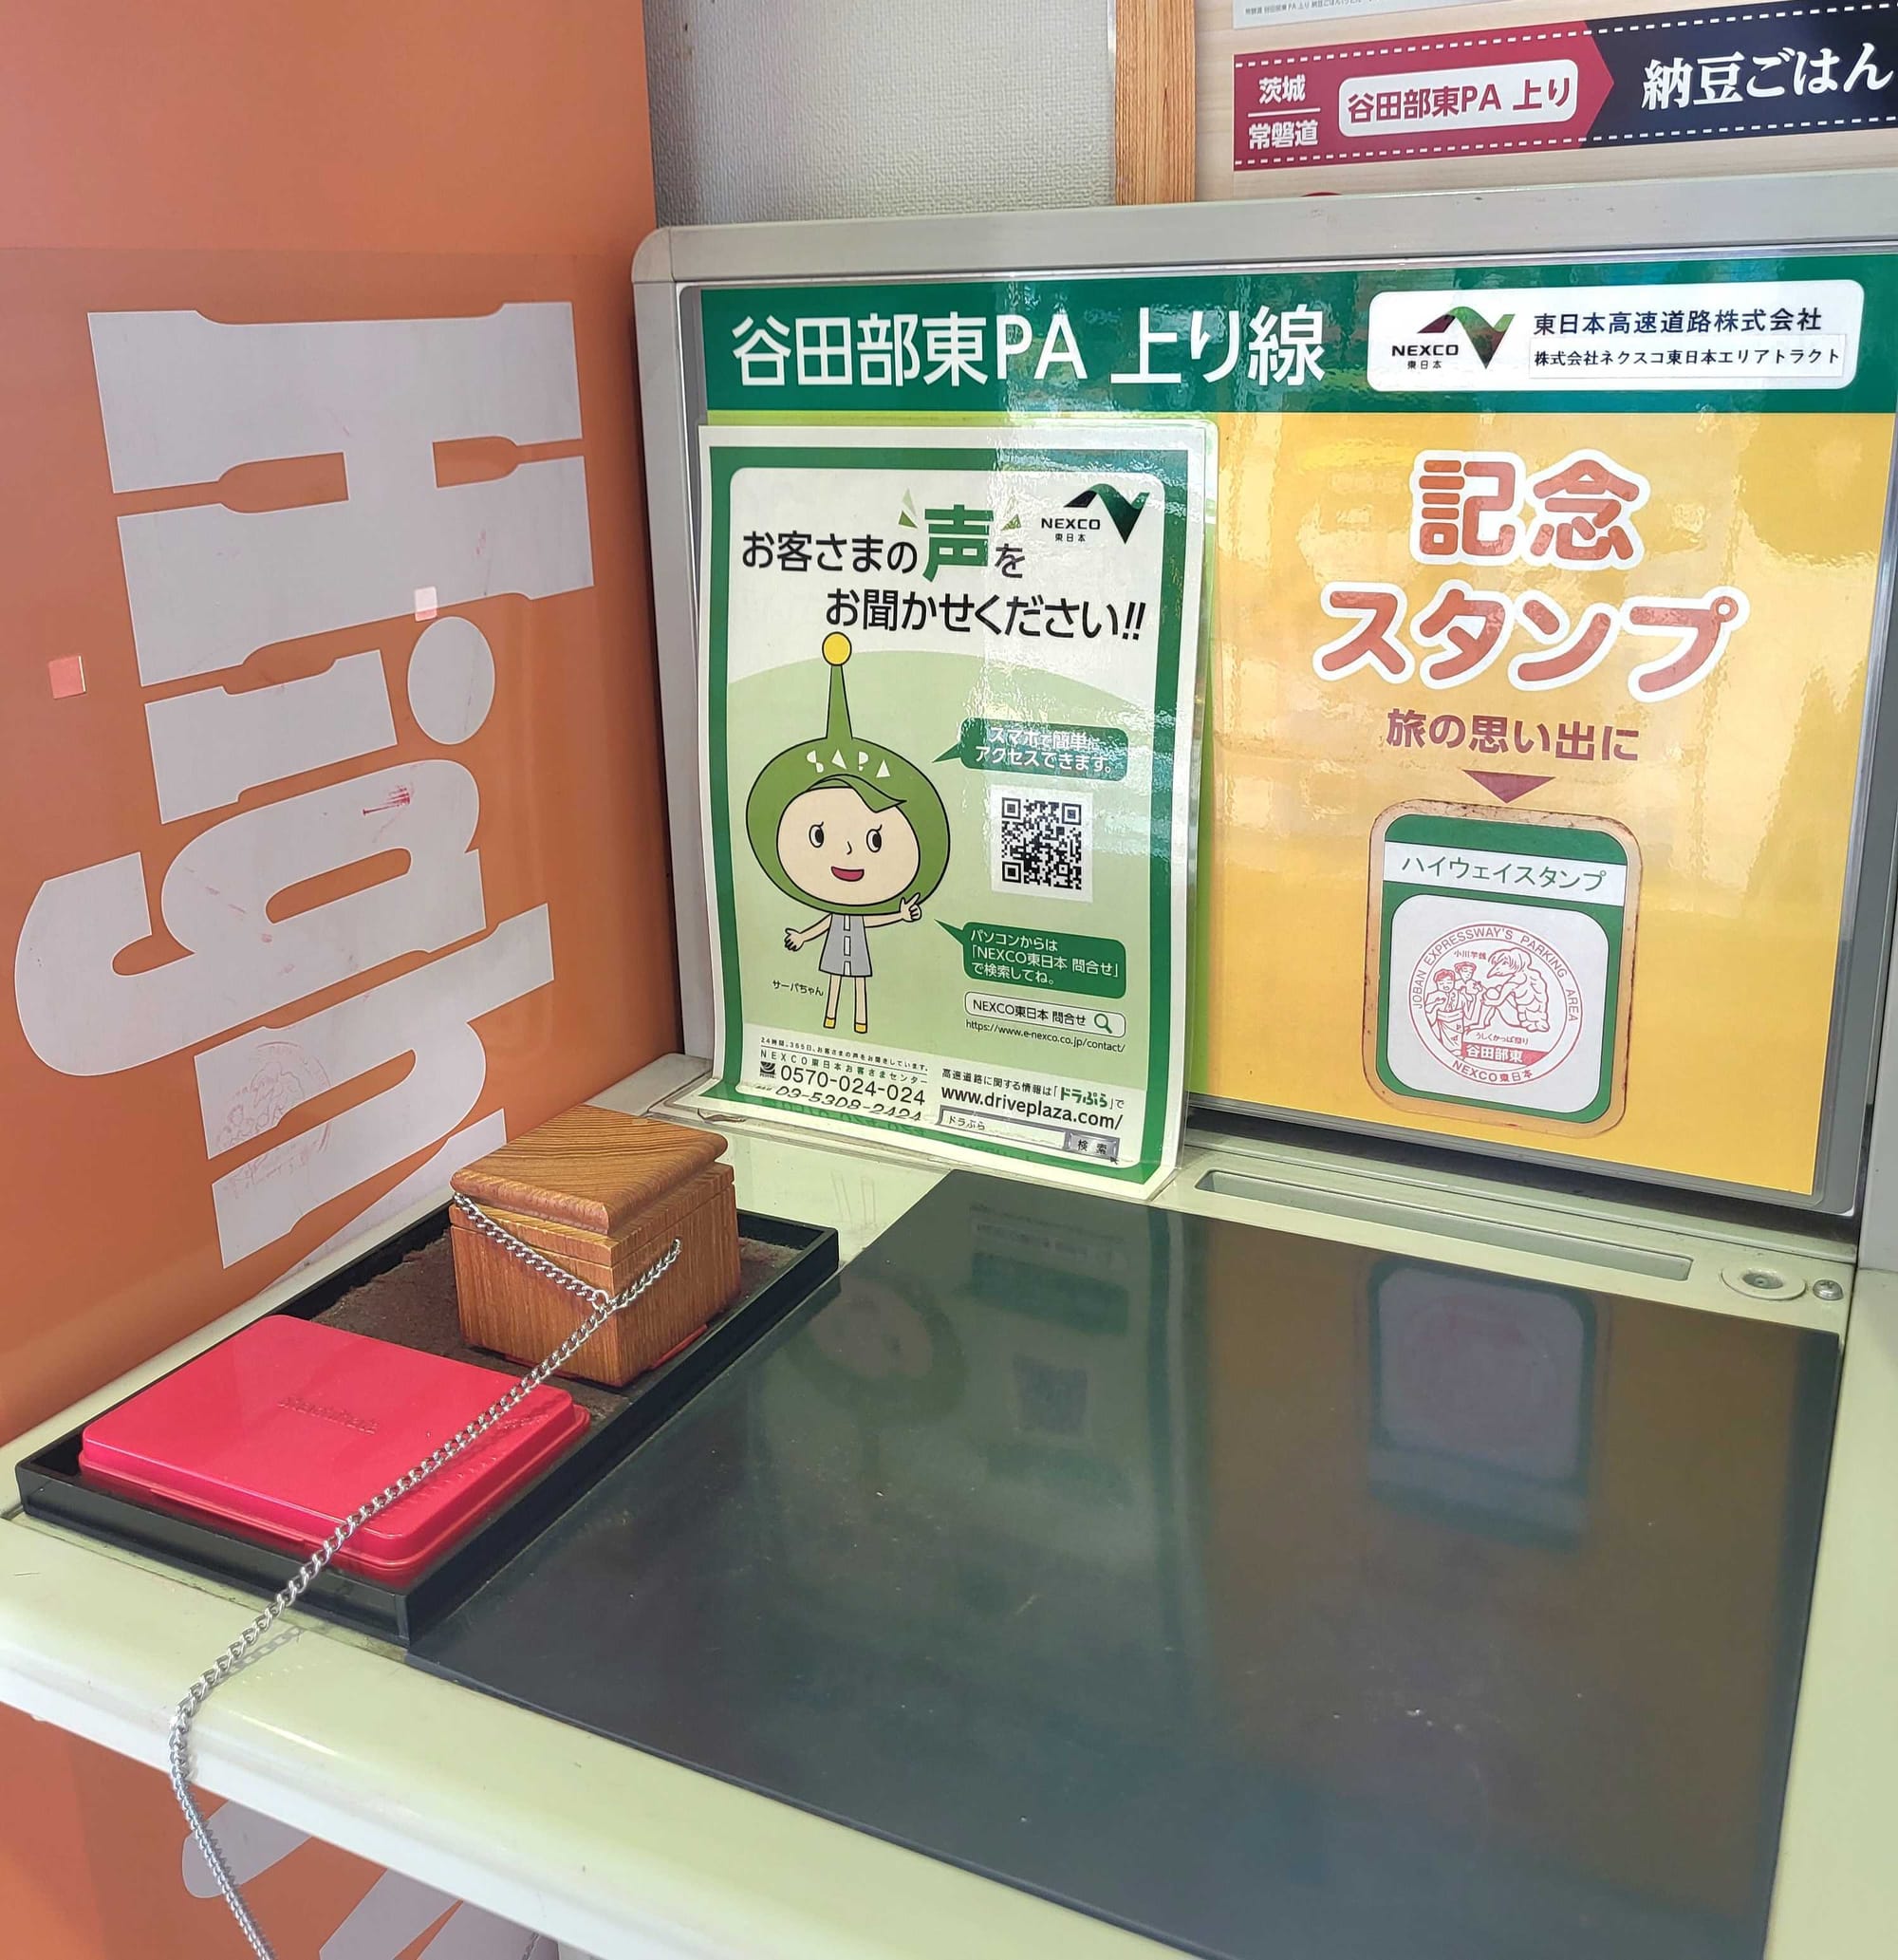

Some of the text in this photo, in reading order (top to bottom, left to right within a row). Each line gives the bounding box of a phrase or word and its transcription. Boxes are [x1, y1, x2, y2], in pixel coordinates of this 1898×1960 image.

[1258, 74, 1307, 105] 茨城
[1642, 41, 1894, 110] 納豆ごはん
[1347, 75, 1572, 124] 谷田部東PA 上り
[1248, 118, 1319, 151] 常磐道
[1533, 306, 1822, 337] 東日本高速道路株式会社
[732, 304, 1327, 387] 谷田部東PA 上り線
[1391, 344, 1460, 358] NEXCO
[1534, 347, 1841, 367] 株式会社ネクスコ東日本エリアトラクト
[1406, 360, 1442, 370] 東日本
[1041, 517, 1101, 531] NEXCO
[1414, 454, 1645, 566] 記念
[742, 504, 1025, 583] お客さまの声を
[1054, 533, 1087, 543] 東日本
[1316, 583, 1744, 699] スタンプ
[989, 727, 1100, 751] スマホで簡単に
[1386, 708, 1640, 761] 旅の思い出に
[976, 746, 1111, 774] アクセスできます。
[1402, 856, 1607, 892] ハイウェイスタンプ
[970, 928, 1059, 952] パソコンからは
[772, 980, 824, 997] サーパちゃん
[971, 961, 1054, 985] で検索してね。
[1412, 927, 1579, 1022] JOBAN EXPRESSWAY'S PARKING AREA
[973, 999, 1087, 1026] NEXCO東日本 問合せ
[965, 1019, 1126, 1053] https://www.e-nexco.co.jp/contact/
[760, 1049, 928, 1084] NEXCO東日本お客さまセンター
[1466, 1044, 1523, 1063] 谷田部東
[780, 1064, 926, 1106] 0570-024-024
[775, 1086, 922, 1122] 03-5308-2424
[940, 1085, 1124, 1130] www.driveplaza.com/
[948, 1114, 986, 1131] ドラぷら
[1077, 1138, 1108, 1155] 検索
